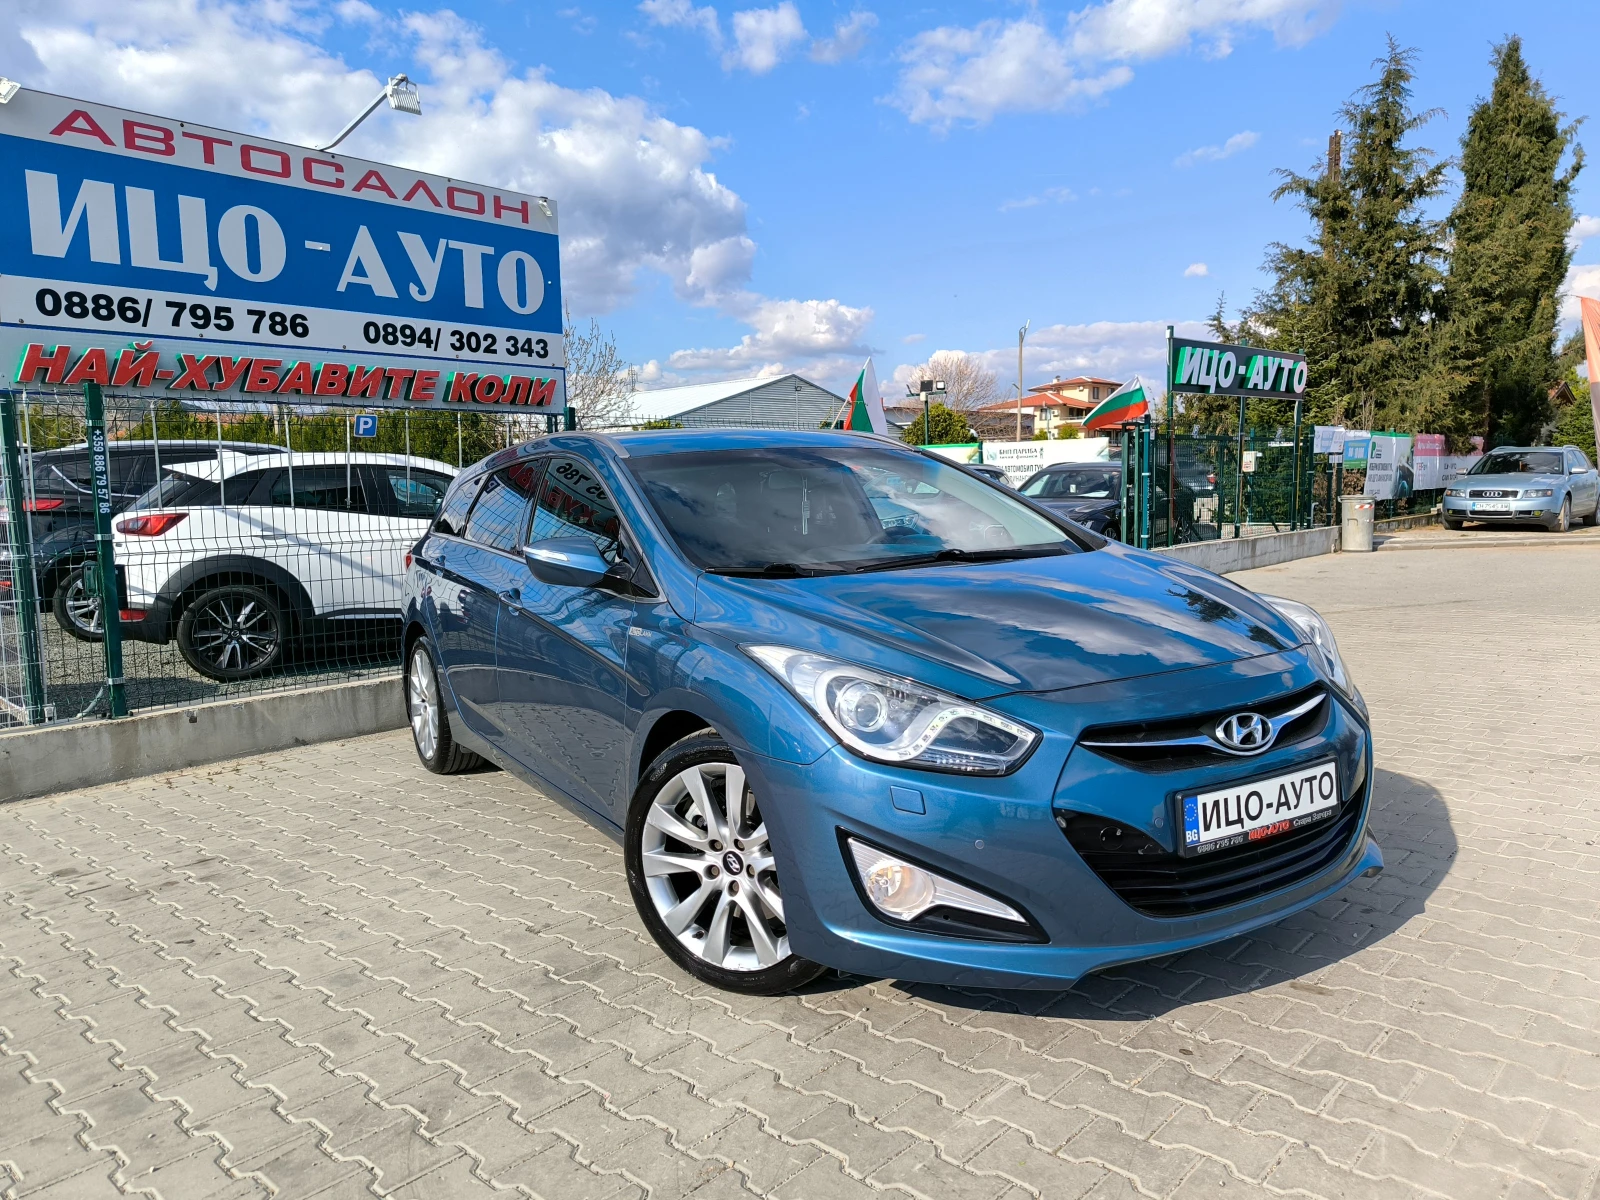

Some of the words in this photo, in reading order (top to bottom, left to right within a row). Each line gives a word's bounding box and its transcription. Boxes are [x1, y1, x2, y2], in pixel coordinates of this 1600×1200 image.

[49, 109, 529, 224] АВТОСАЛОН
[35, 288, 153, 327] 0886/
[165, 300, 235, 332] 795
[247, 308, 310, 338] 786
[363, 321, 442, 351] 0894/
[450, 329, 498, 355] 302
[505, 336, 549, 359] 343
[17, 340, 440, 400] НАЙ-ХУБАВИТЕ
[447, 371, 557, 406] КОЛИ
[358, 417, 373, 435] P
[93, 429, 104, 452] +359
[94, 454, 106, 472] 886
[96, 473, 107, 486] 79
[97, 488, 109, 500] 57
[99, 501, 111, 514] 86
[1202, 771, 1334, 833] ИЦО-АУТО
[1186, 829, 1199, 843] BG
